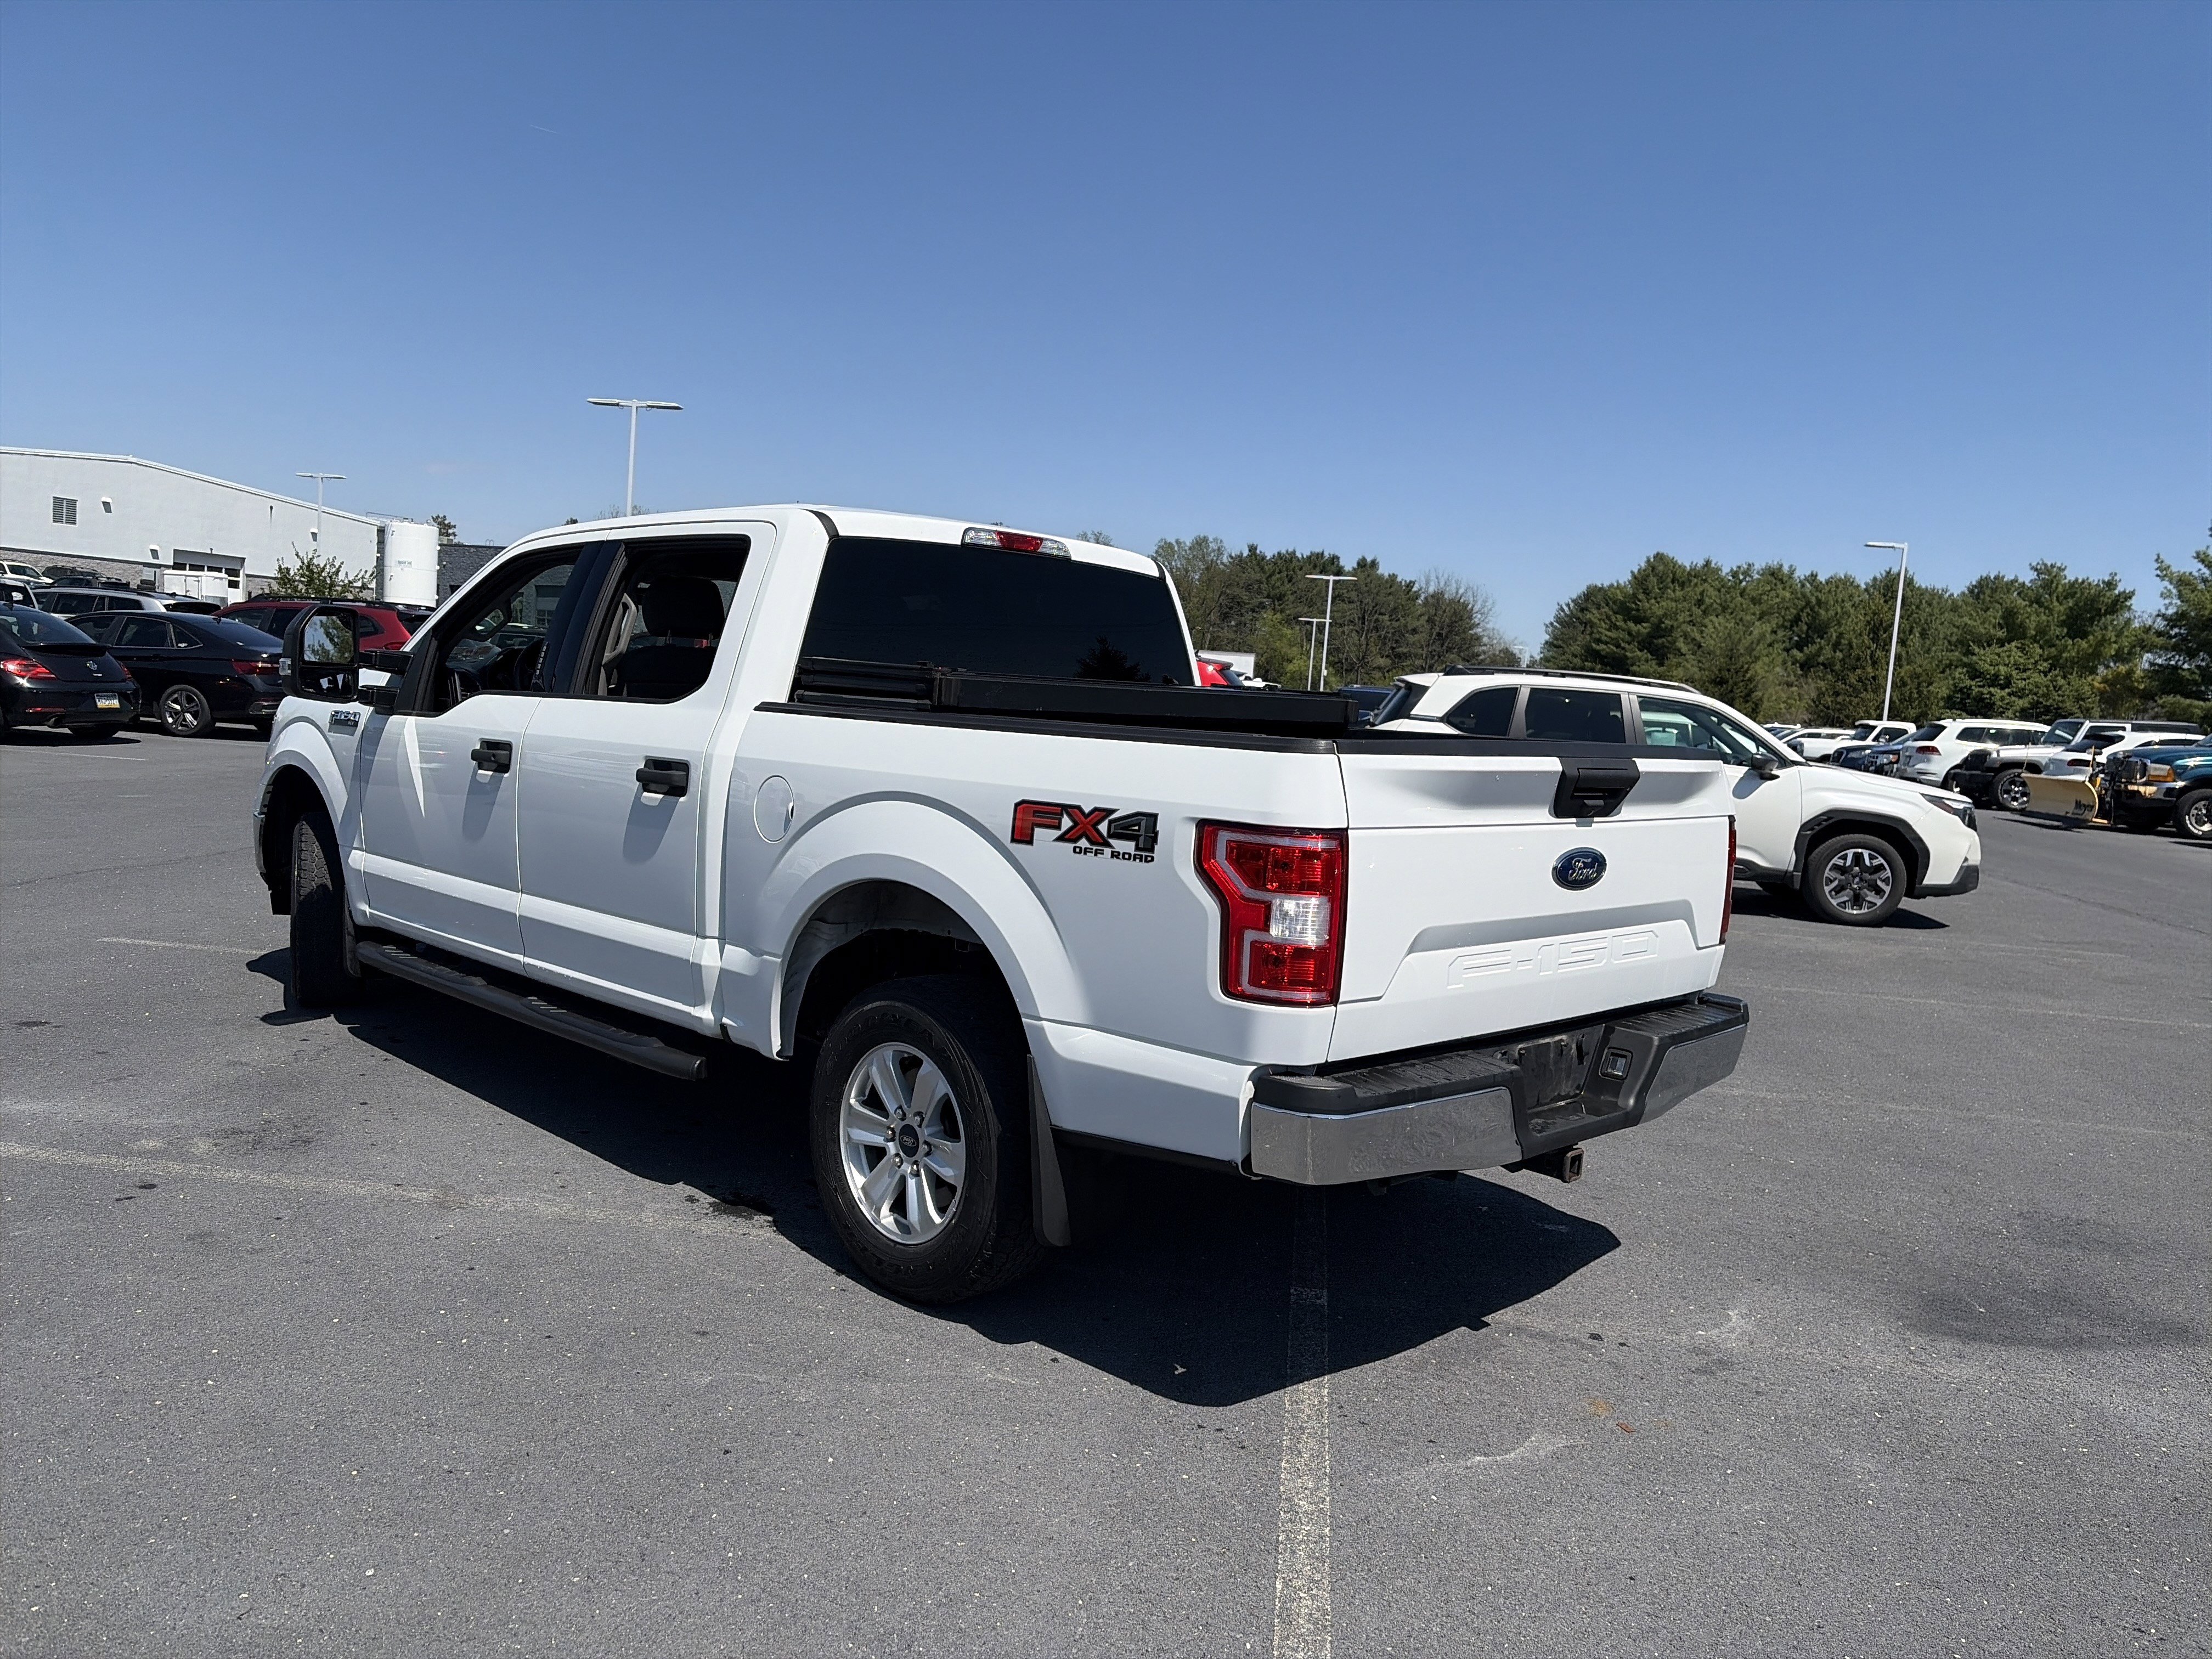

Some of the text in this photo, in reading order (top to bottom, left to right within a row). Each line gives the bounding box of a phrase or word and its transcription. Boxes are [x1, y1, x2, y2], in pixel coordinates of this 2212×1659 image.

[1010, 799, 1159, 854] FX4
[1073, 845, 1155, 863] OFF ROAD
[1568, 857, 1598, 881] Ford
[1447, 930, 1658, 989] F-150
